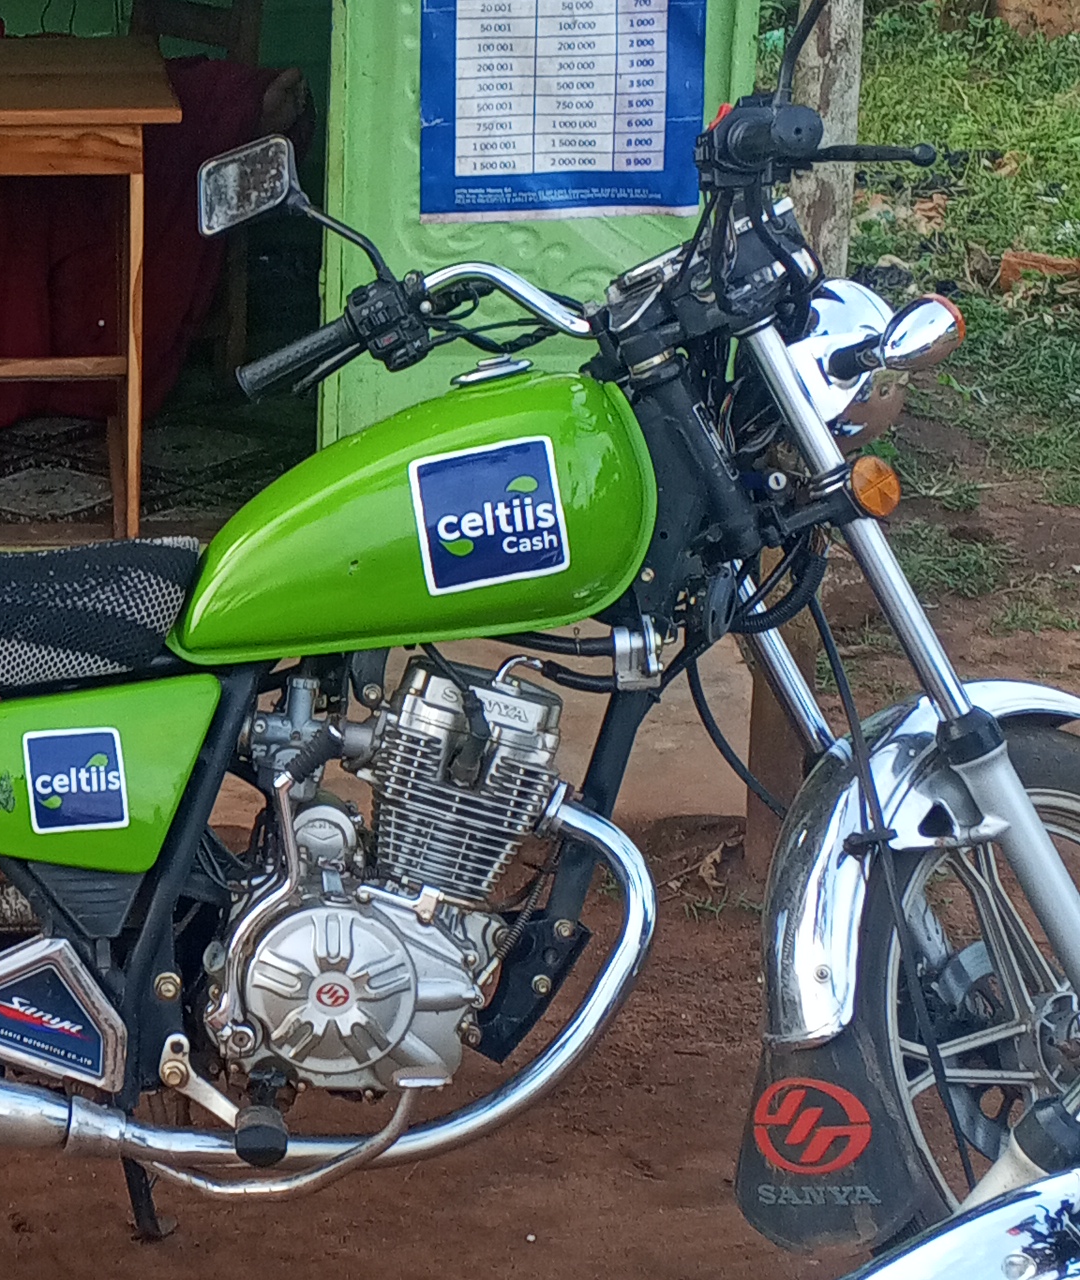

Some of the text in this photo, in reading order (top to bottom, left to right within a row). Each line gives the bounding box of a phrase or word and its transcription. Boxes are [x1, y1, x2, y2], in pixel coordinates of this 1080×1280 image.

[480, 3, 512, 13] 20 001
[561, 1, 594, 10] 50 000
[558, 21, 597, 31] 100 000
[636, 18, 655, 27] 000
[480, 23, 512, 33] 50 001
[477, 43, 514, 52] 100 001
[557, 41, 596, 50] 200 000
[636, 38, 655, 47] 000
[477, 62, 513, 72] 200 001
[557, 61, 595, 71] 300 000
[477, 82, 513, 92] 300 001
[556, 81, 595, 90] 500 000
[477, 101, 513, 111] 500 001
[556, 100, 594, 110] 750 000
[477, 121, 513, 131] 750 001
[559, 120, 577, 129] 000
[578, 120, 597, 129] 000
[635, 118, 653, 127] 000
[480, 141, 497, 151] 000
[499, 141, 516, 151] 001
[559, 138, 576, 147] 500
[578, 138, 596, 147] 000
[479, 160, 497, 170] 500
[499, 160, 517, 170] 001
[558, 157, 576, 166] 000
[578, 157, 596, 166] 000
[437, 497, 556, 541] celtiis
[502, 531, 558, 554] Cash
[441, 687, 529, 724] SNYA
[35, 766, 121, 795] celtiis
[758, 1183, 882, 1207] SANYA
